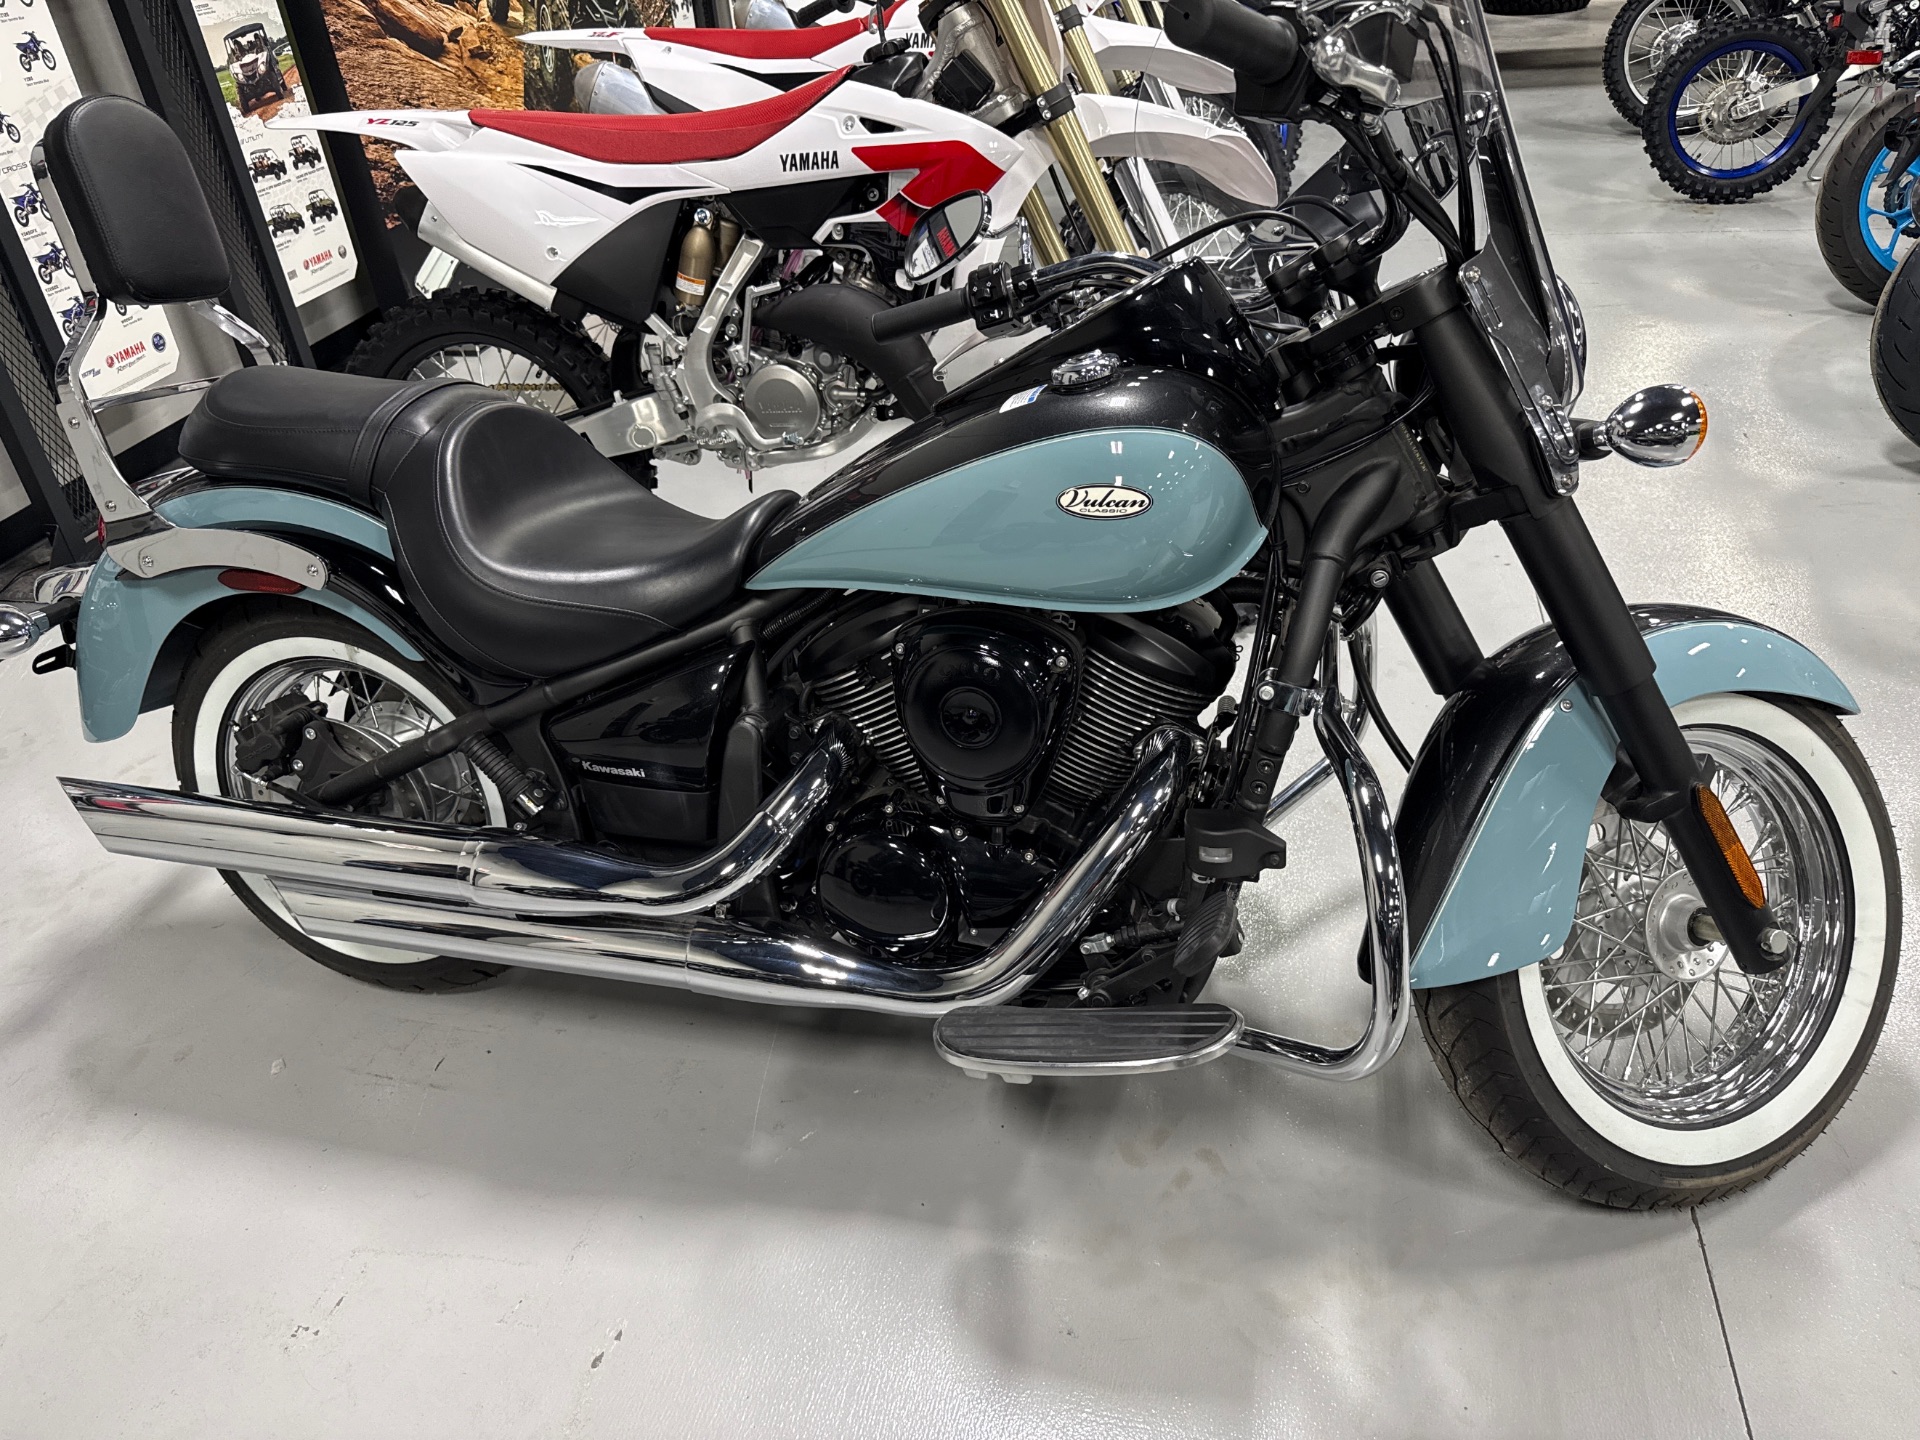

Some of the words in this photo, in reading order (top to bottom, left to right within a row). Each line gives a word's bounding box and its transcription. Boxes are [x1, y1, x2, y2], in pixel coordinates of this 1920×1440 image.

[367, 118, 420, 127] YZ125
[245, 133, 264, 144] UTILITY
[2, 162, 28, 174] CROSS
[779, 150, 839, 172] YAMAHA
[309, 249, 334, 268] YAMAHA
[113, 341, 147, 364] YAMAHA
[1064, 489, 1148, 508] Vulcan
[581, 760, 646, 778] Kawasaki
